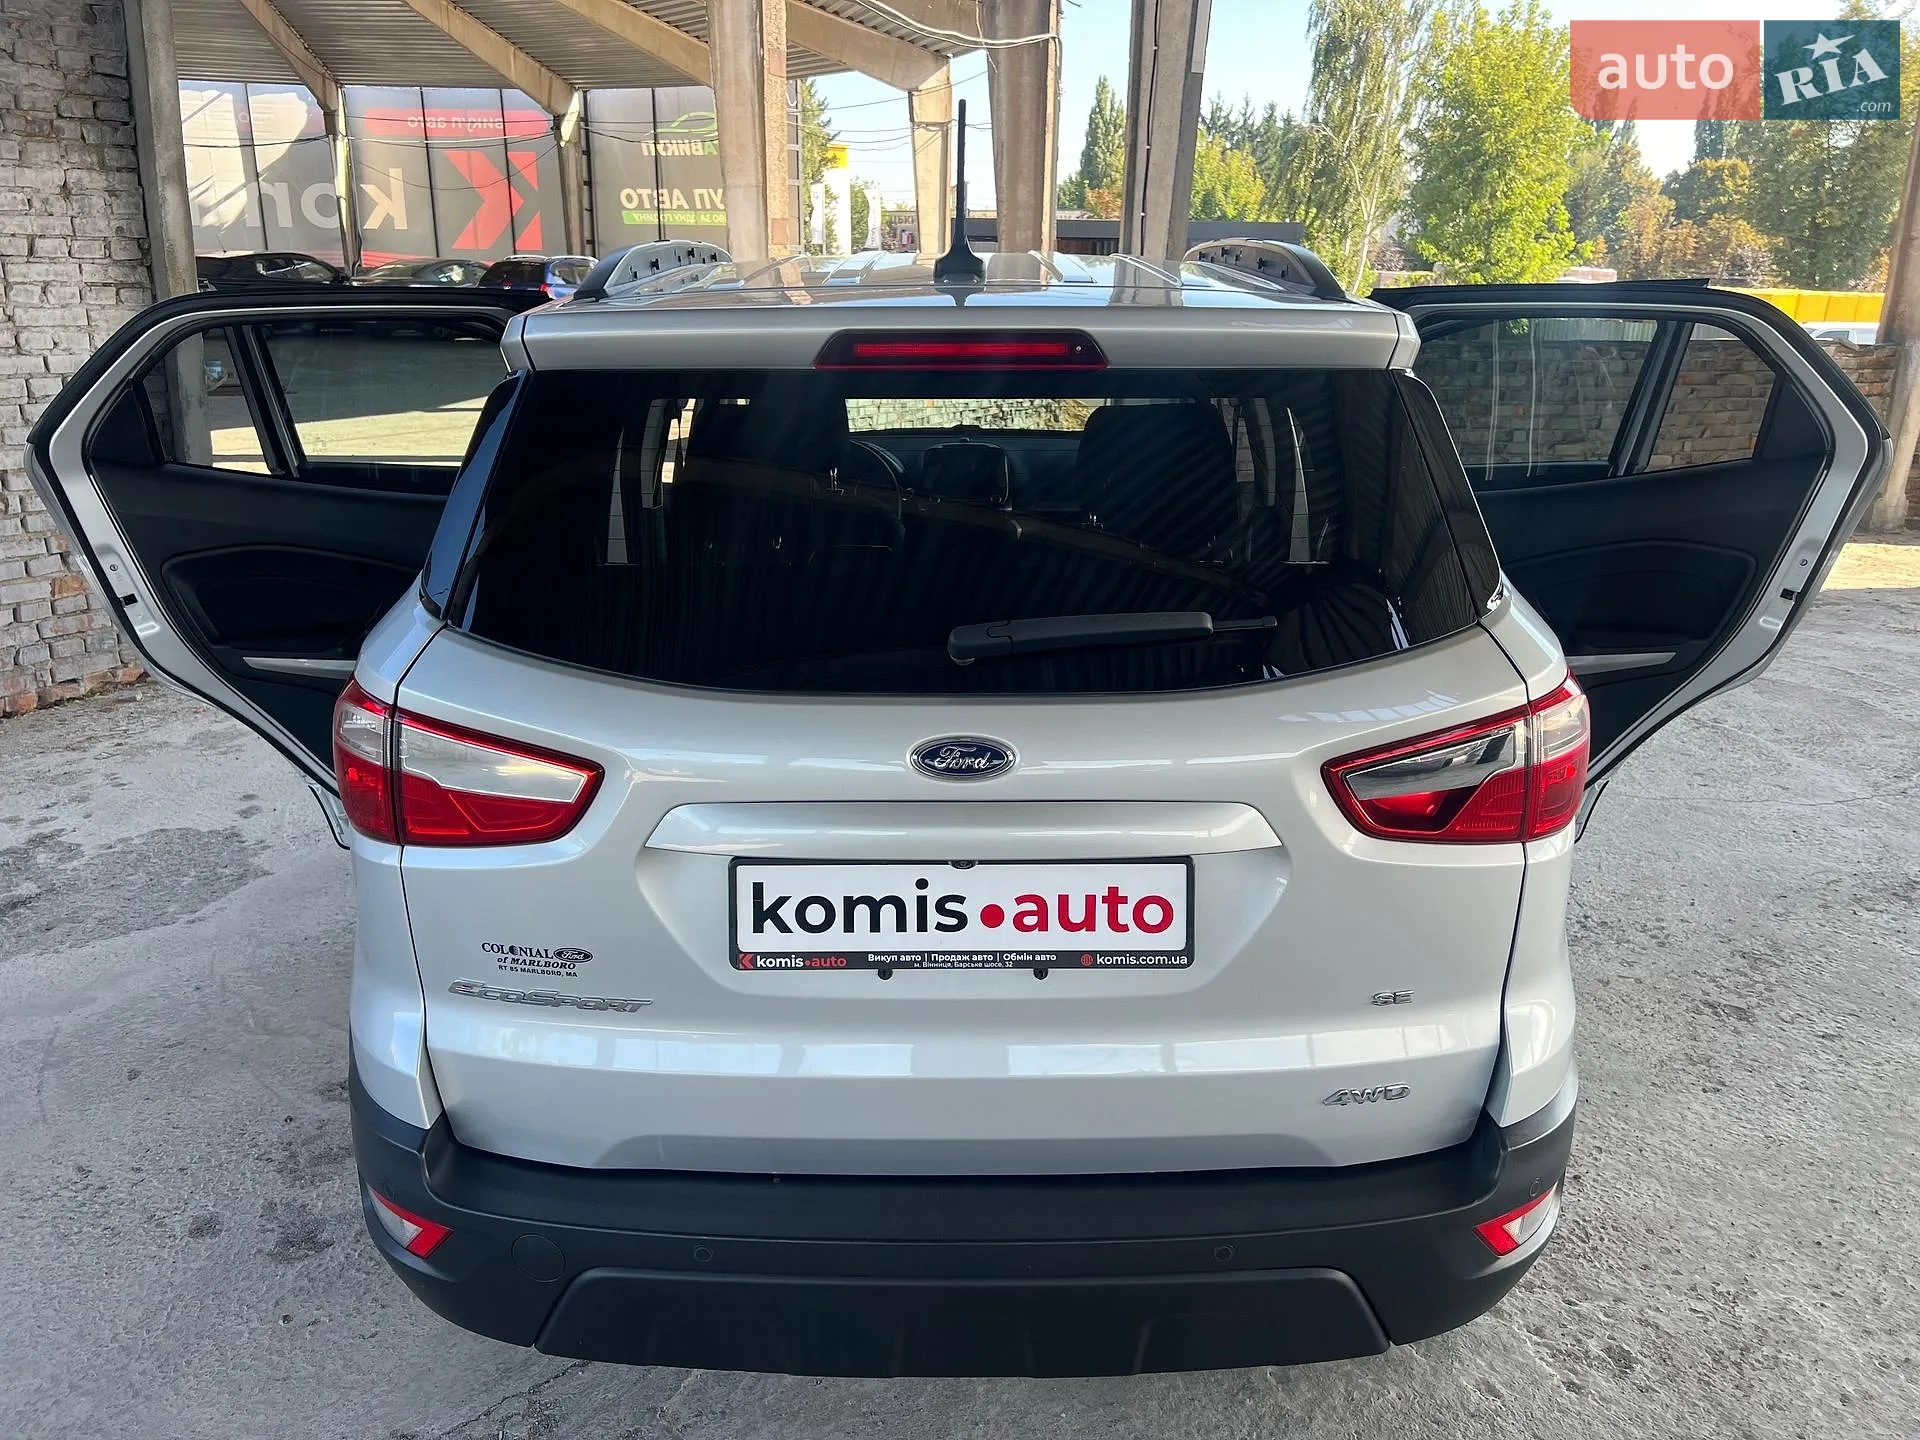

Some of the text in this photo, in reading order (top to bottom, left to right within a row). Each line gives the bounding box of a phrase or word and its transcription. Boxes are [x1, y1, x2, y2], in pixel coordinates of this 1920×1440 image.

[752, 878, 1175, 934] komis auto
[510, 957, 576, 970] MARLBORO
[867, 953, 1057, 963] Викуп авто Продаж авто Обмін авто
[1096, 953, 1188, 966] komis.com.ua
[520, 967, 565, 977] MARLBORO,
[1371, 989, 1414, 1007] SE
[1322, 1082, 1411, 1106] 4WD
